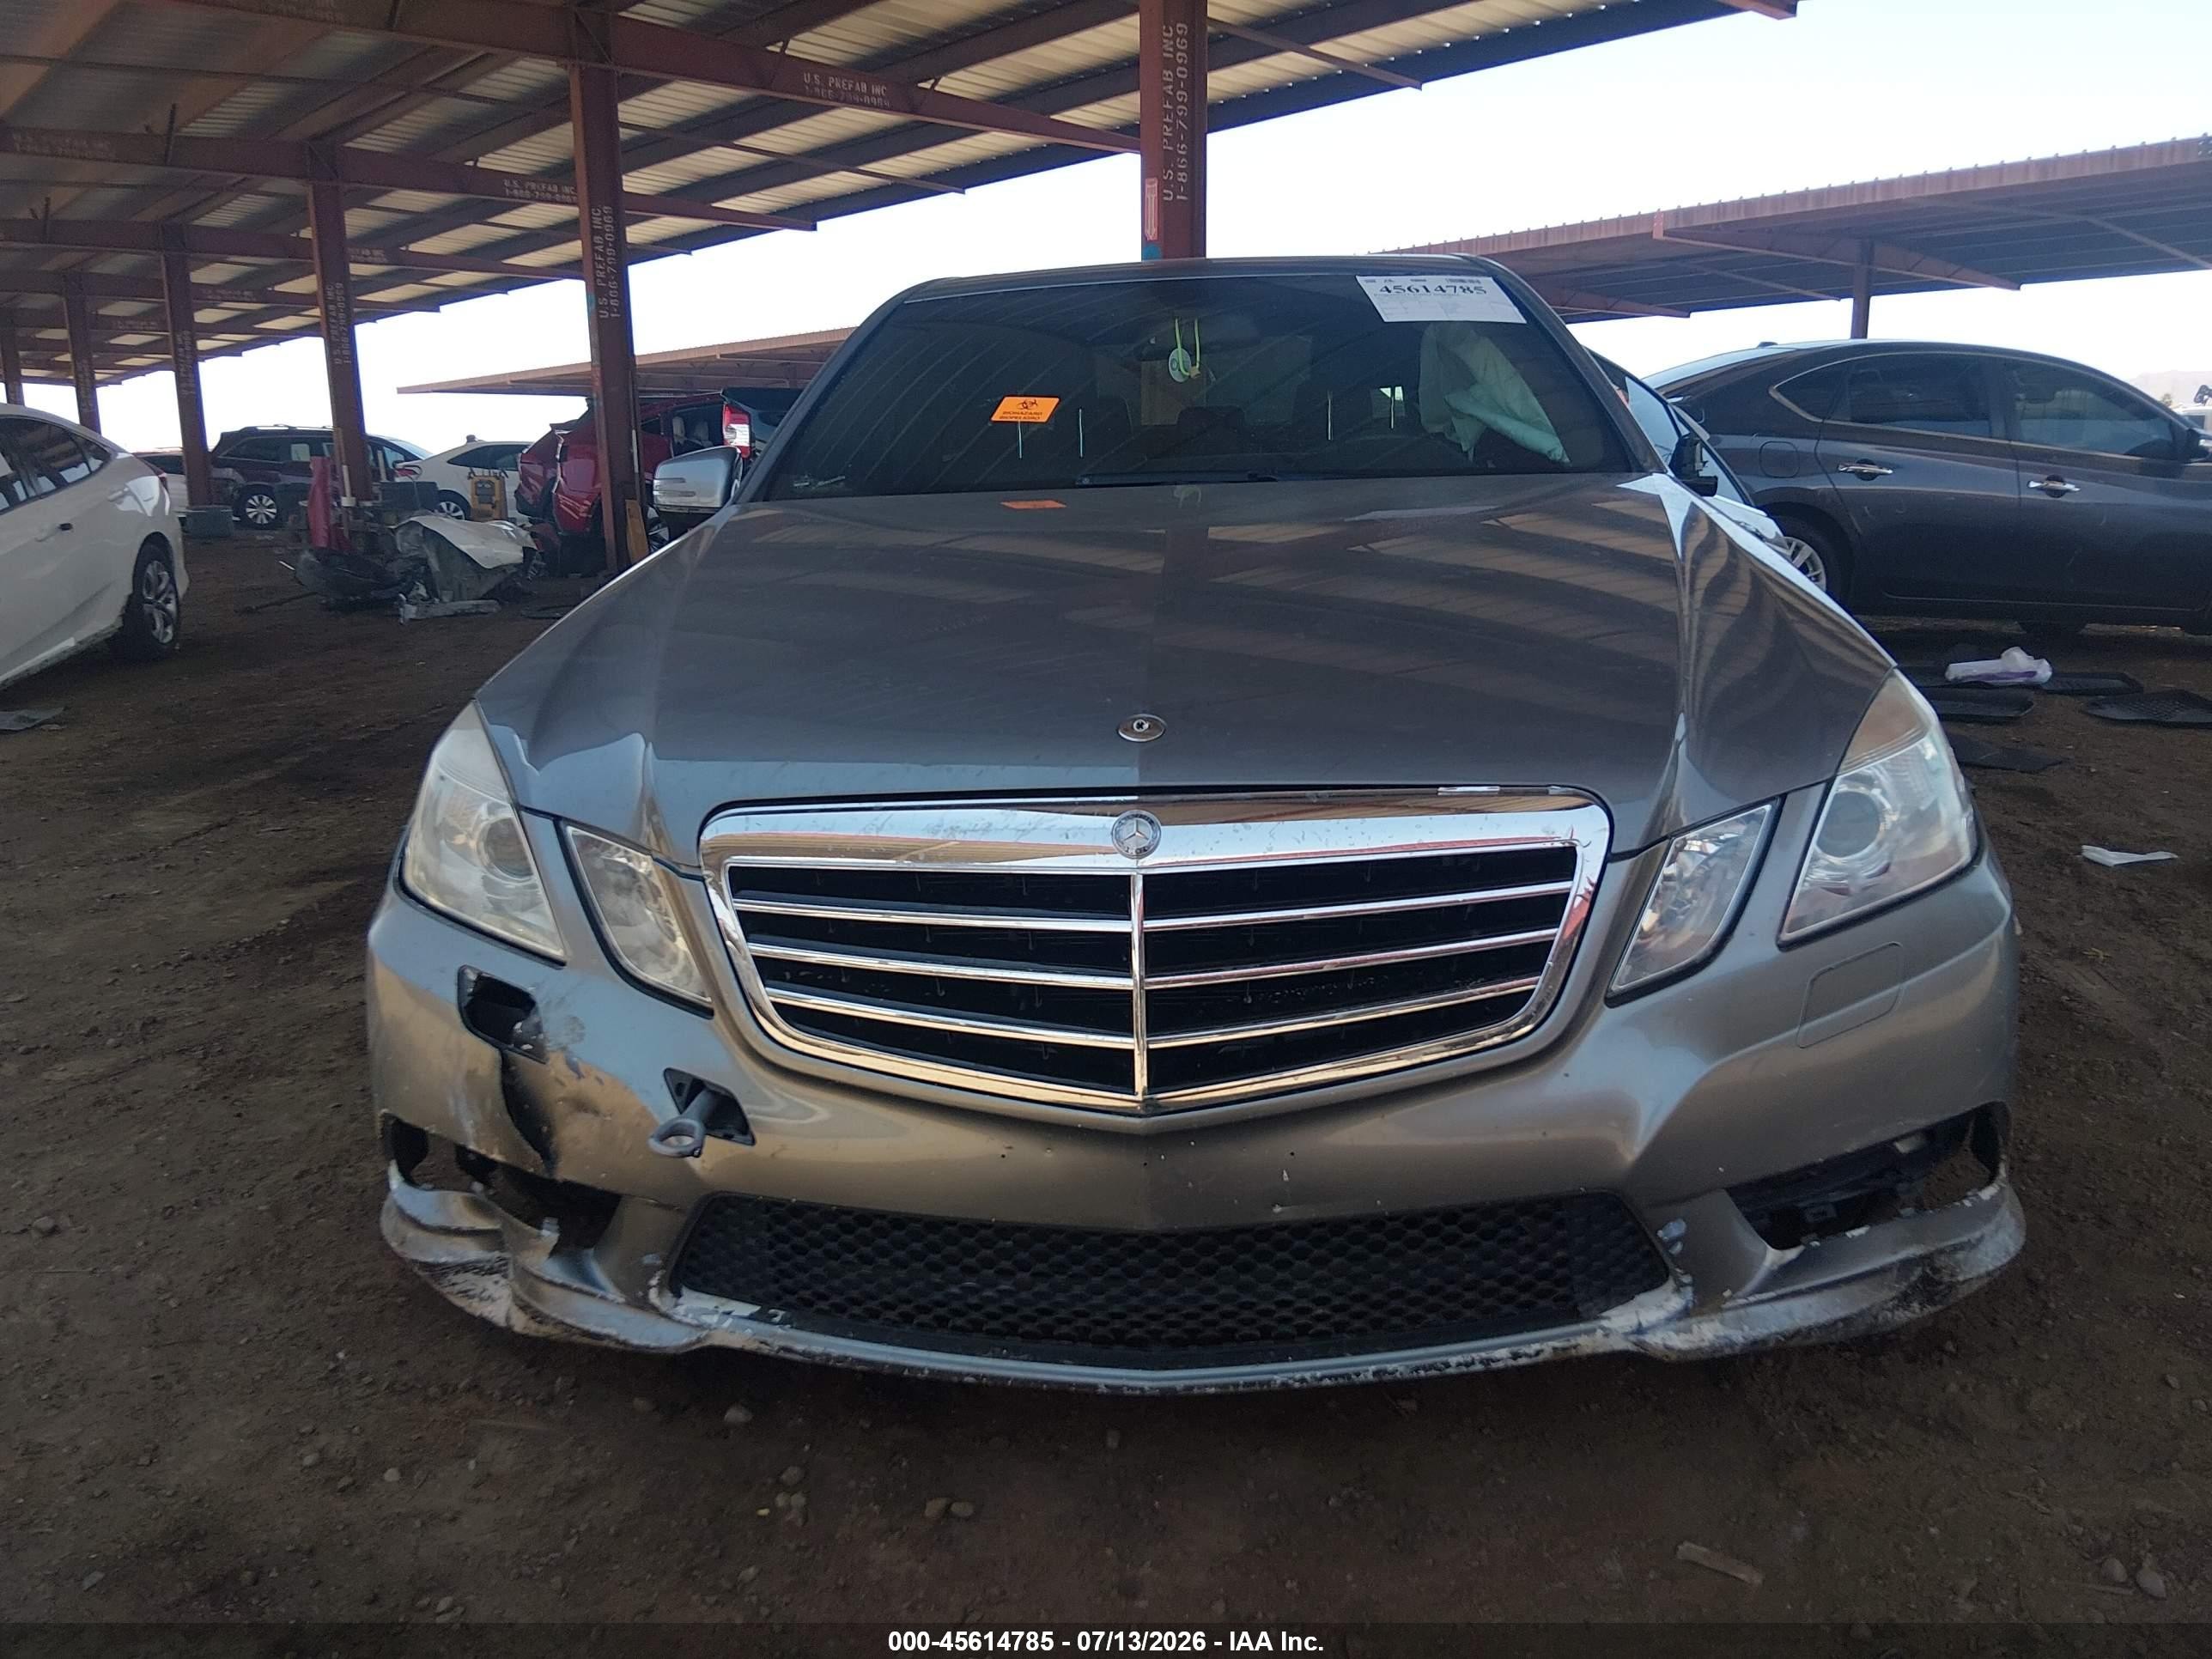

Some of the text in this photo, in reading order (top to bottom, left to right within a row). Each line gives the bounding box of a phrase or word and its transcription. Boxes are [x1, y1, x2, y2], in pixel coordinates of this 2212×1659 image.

[828, 76, 868, 94] PREFAB
[1163, 70, 1174, 151] PREFAB
[1176, 22, 1188, 201] 1-866-799-0969
[1163, 163, 1174, 201] U.S.
[592, 235, 606, 286] PREFAB
[1379, 284, 1487, 295] 45614785
